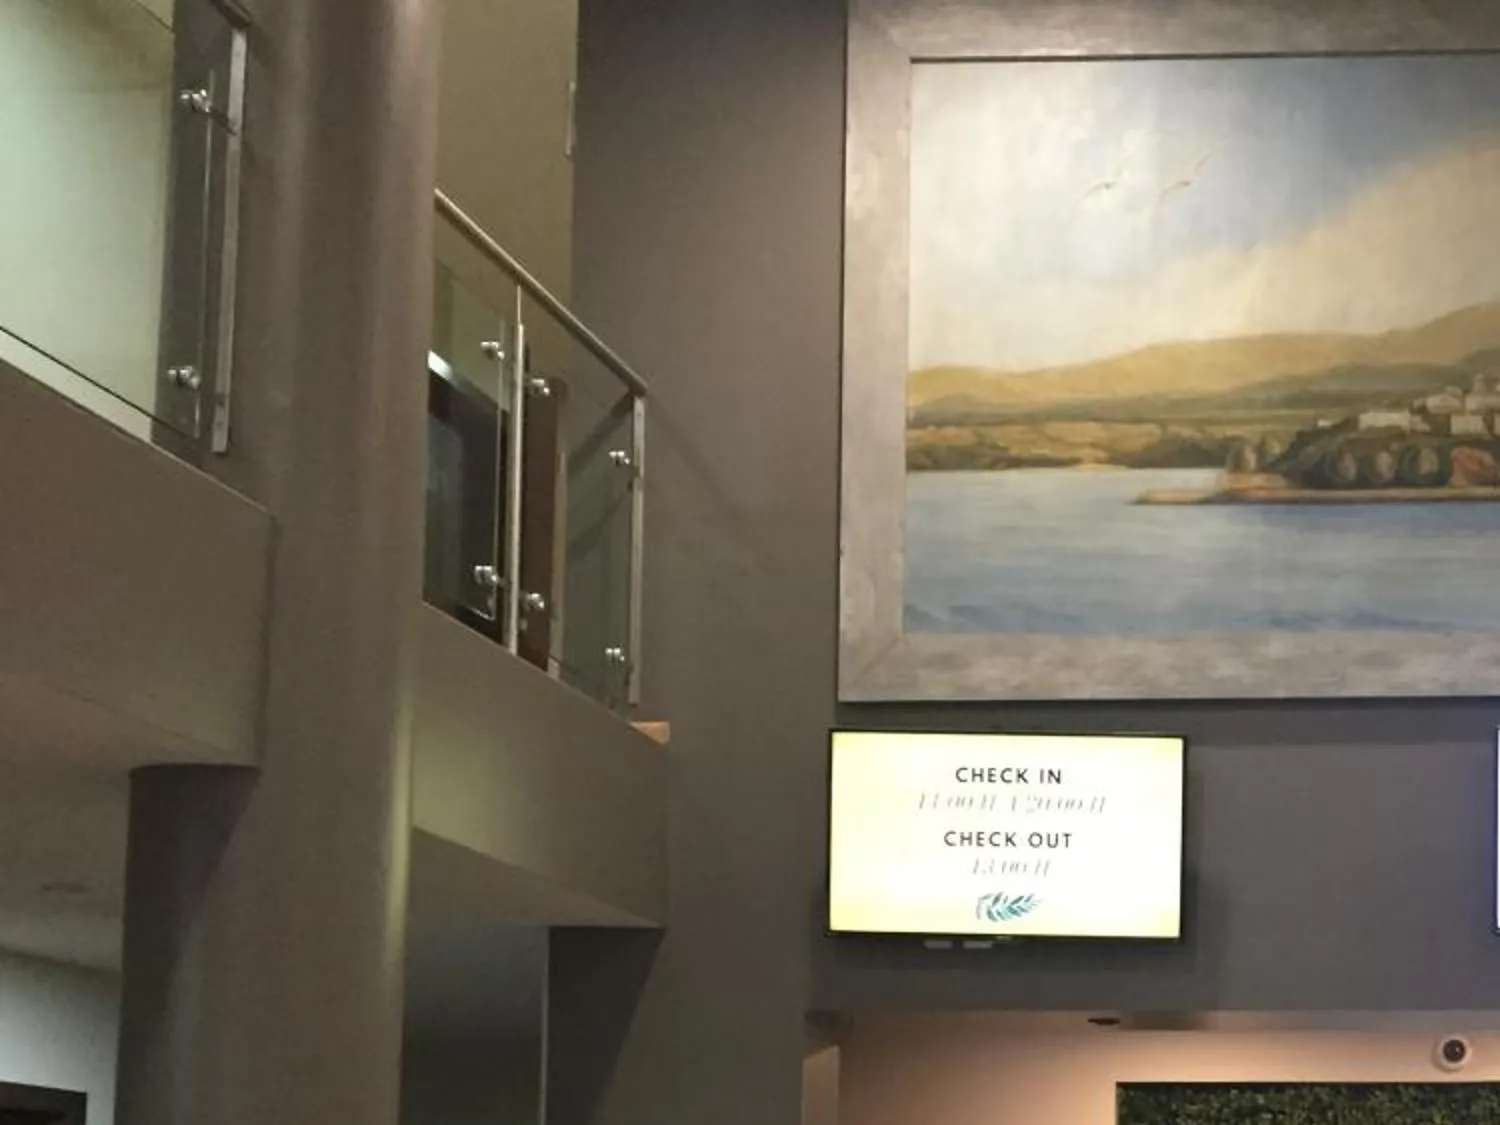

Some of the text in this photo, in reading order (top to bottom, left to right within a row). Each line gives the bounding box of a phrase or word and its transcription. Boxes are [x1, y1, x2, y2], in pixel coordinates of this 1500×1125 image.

[954, 765, 1064, 785] CHECK IN
[942, 829, 1074, 849] CHECK OUT
